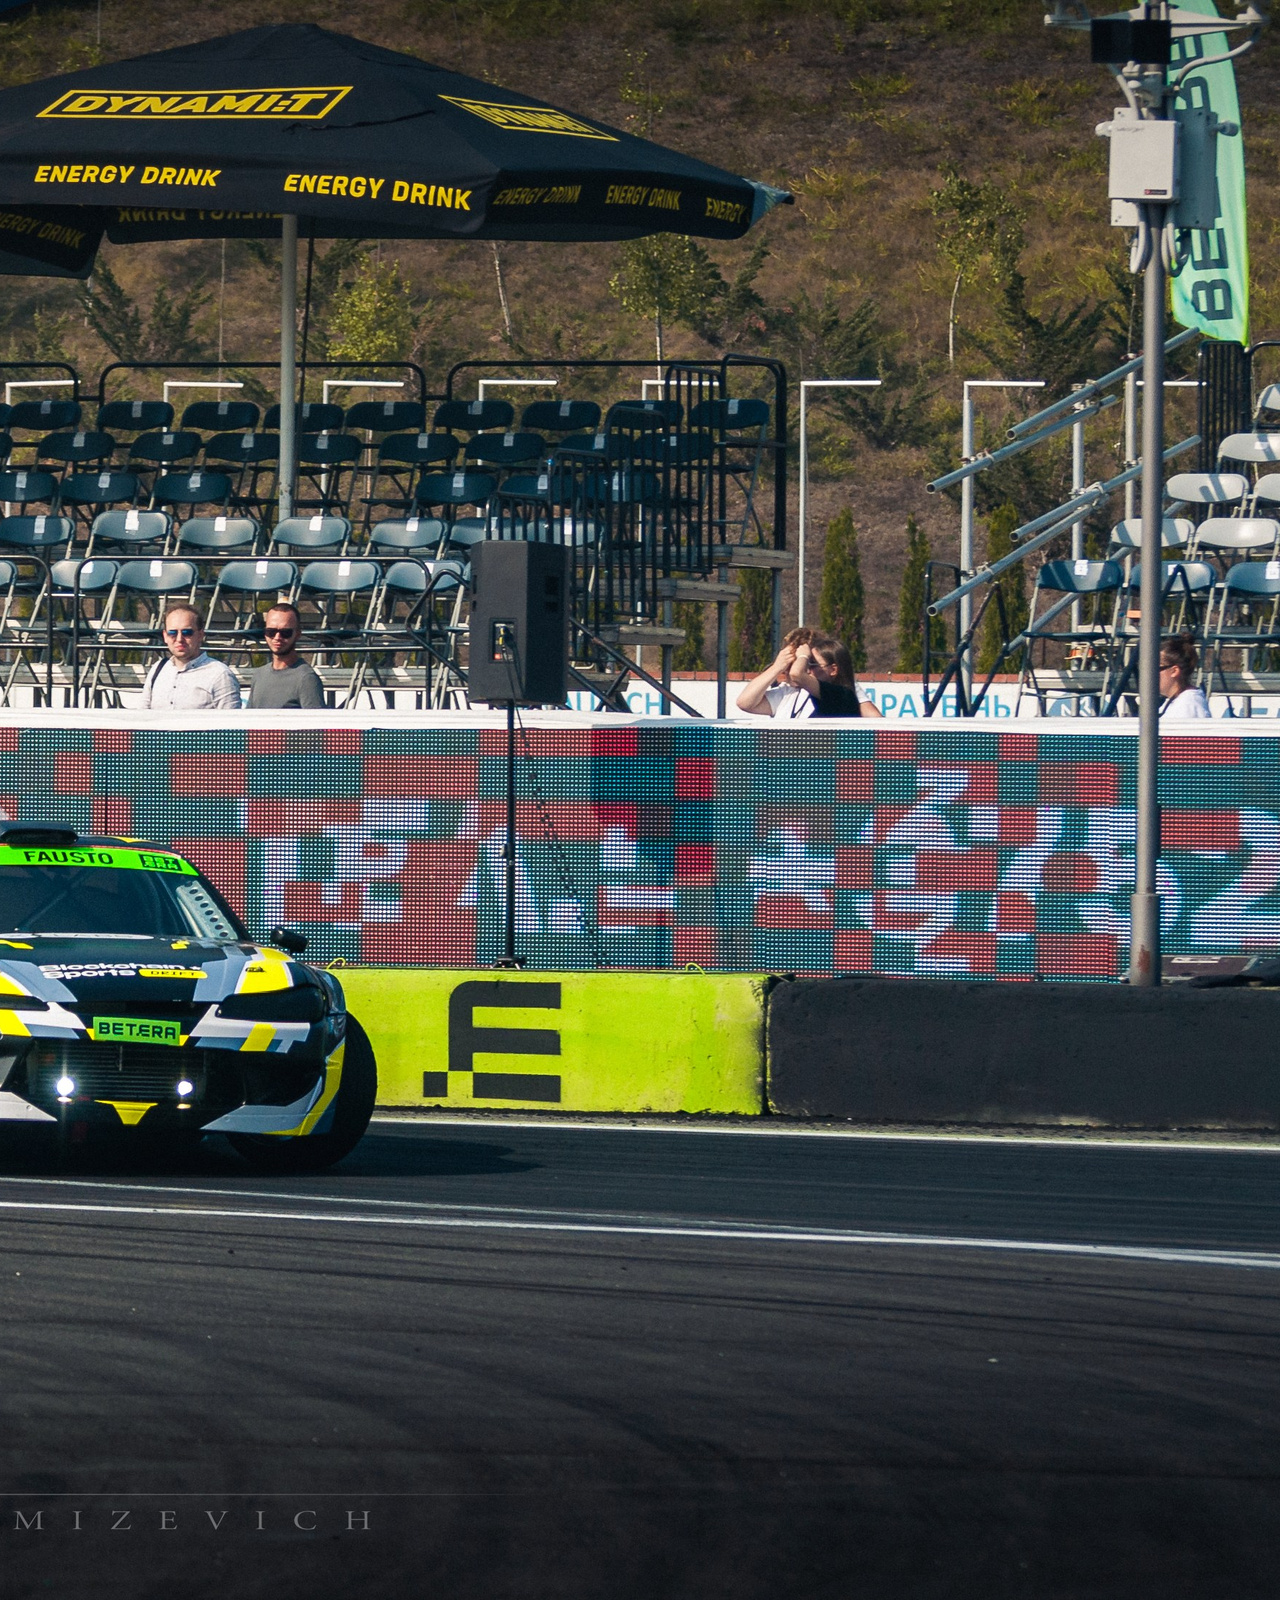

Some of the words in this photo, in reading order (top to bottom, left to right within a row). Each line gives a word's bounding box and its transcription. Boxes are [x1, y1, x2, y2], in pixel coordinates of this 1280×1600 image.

[34, 165, 135, 183] ENERGY
[140, 166, 222, 187] DRINK
[283, 174, 385, 199] ENERGY
[391, 180, 472, 211] DRINK
[493, 187, 544, 206] ENERGY
[543, 184, 582, 204] DRINK
[605, 184, 650, 206] ENERGY
[647, 187, 682, 211] DRINK
[705, 197, 747, 224] ENERGY
[37, 221, 88, 248] DRINK
[23, 850, 114, 865] FAUSTO
[38, 962, 185, 972] Blockchain
[42, 969, 136, 980] Sports
